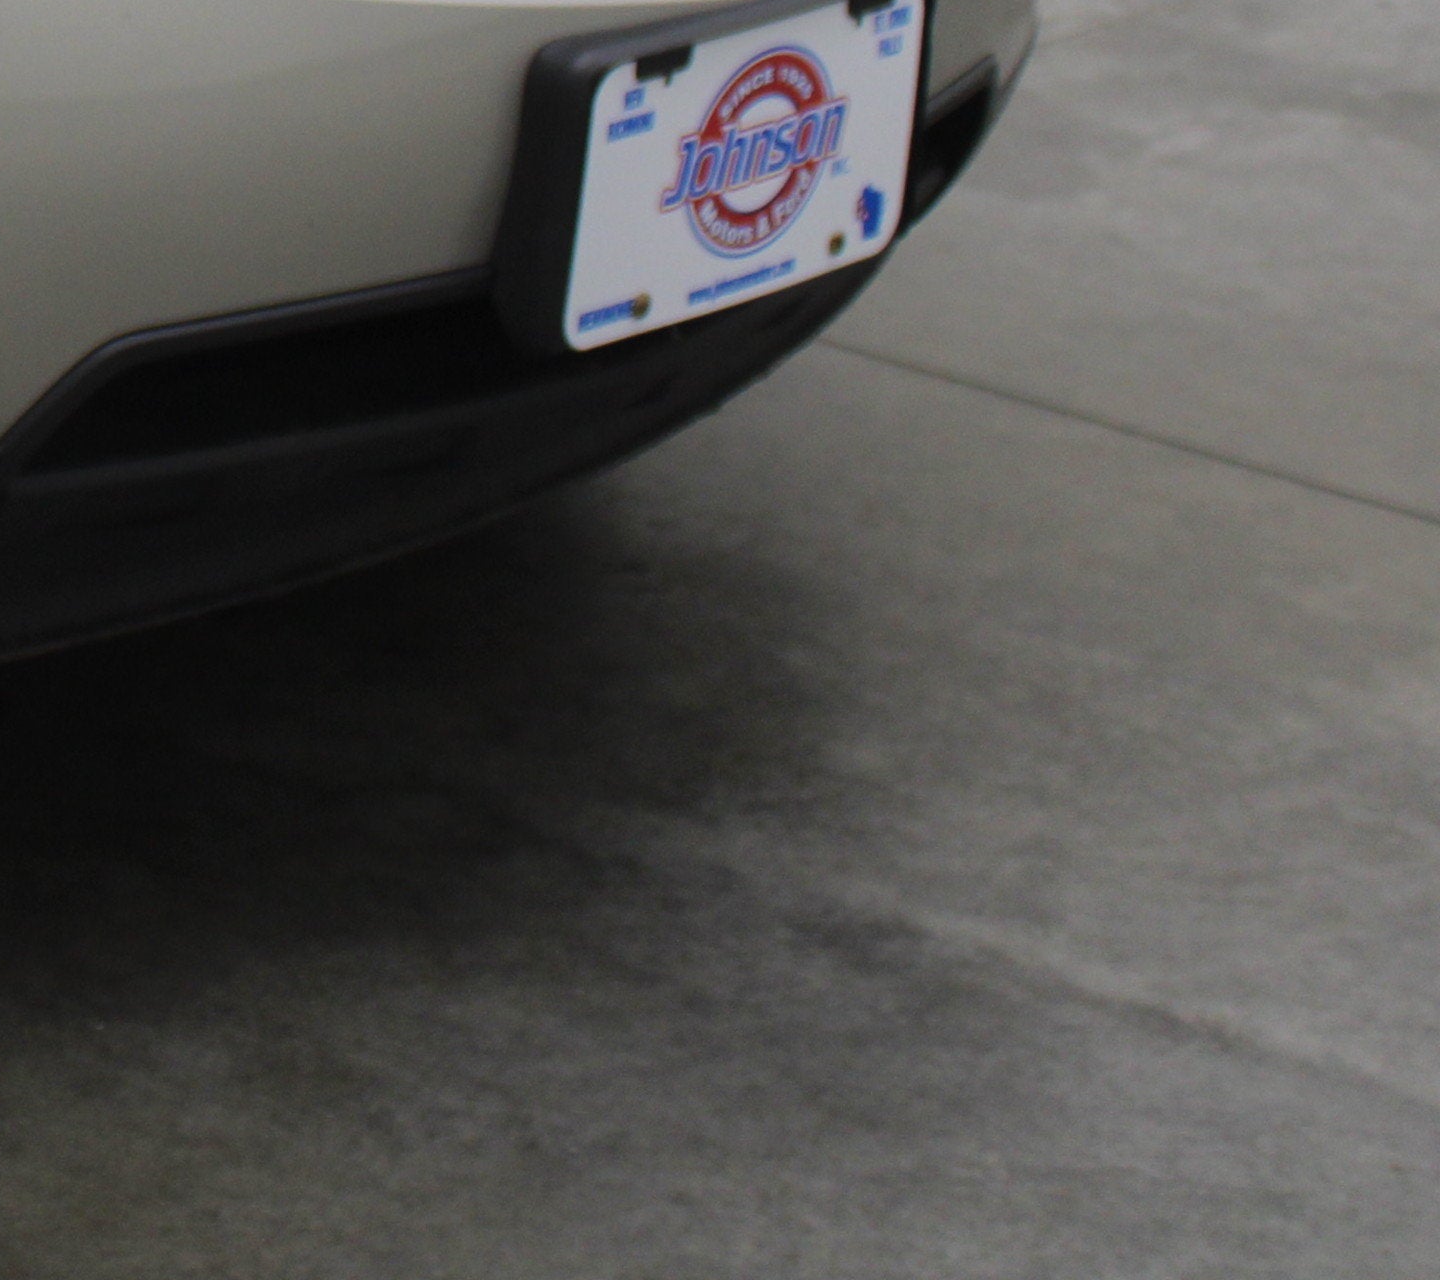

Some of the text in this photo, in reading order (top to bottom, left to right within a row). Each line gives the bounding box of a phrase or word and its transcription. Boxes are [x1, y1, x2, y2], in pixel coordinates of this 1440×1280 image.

[720, 66, 776, 118] SINCE
[661, 100, 848, 210] Johnson
[699, 198, 755, 244] Motors
